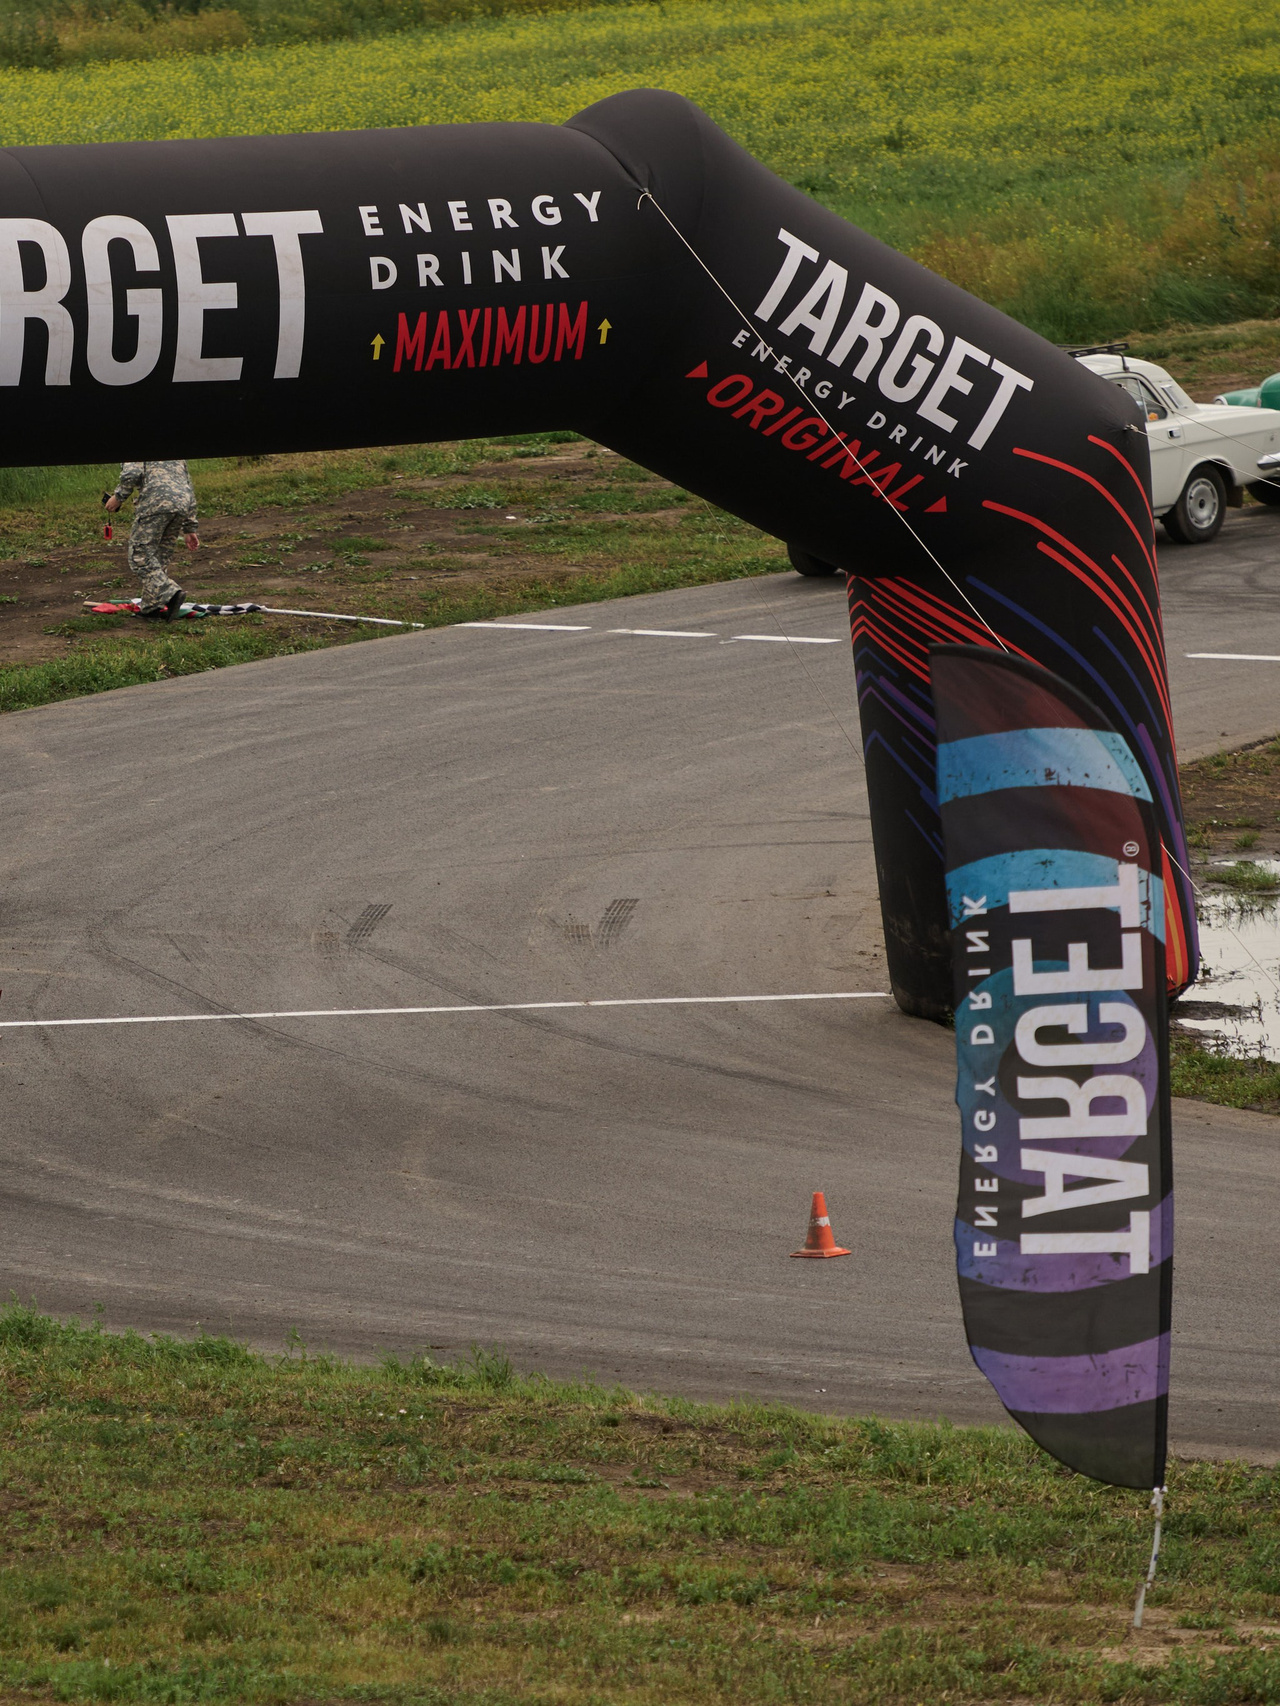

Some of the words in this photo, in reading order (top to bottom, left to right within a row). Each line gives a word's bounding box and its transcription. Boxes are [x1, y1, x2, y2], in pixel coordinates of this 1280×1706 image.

[358, 190, 601, 236] ENERGY
[369, 245, 570, 290] DRINK
[393, 300, 588, 373] MAXIMUM
[753, 227, 1034, 451] TARGET
[706, 373, 925, 512] ORIGINAL
[731, 329, 856, 411] ENERGY
[866, 410, 969, 479] DRINK
